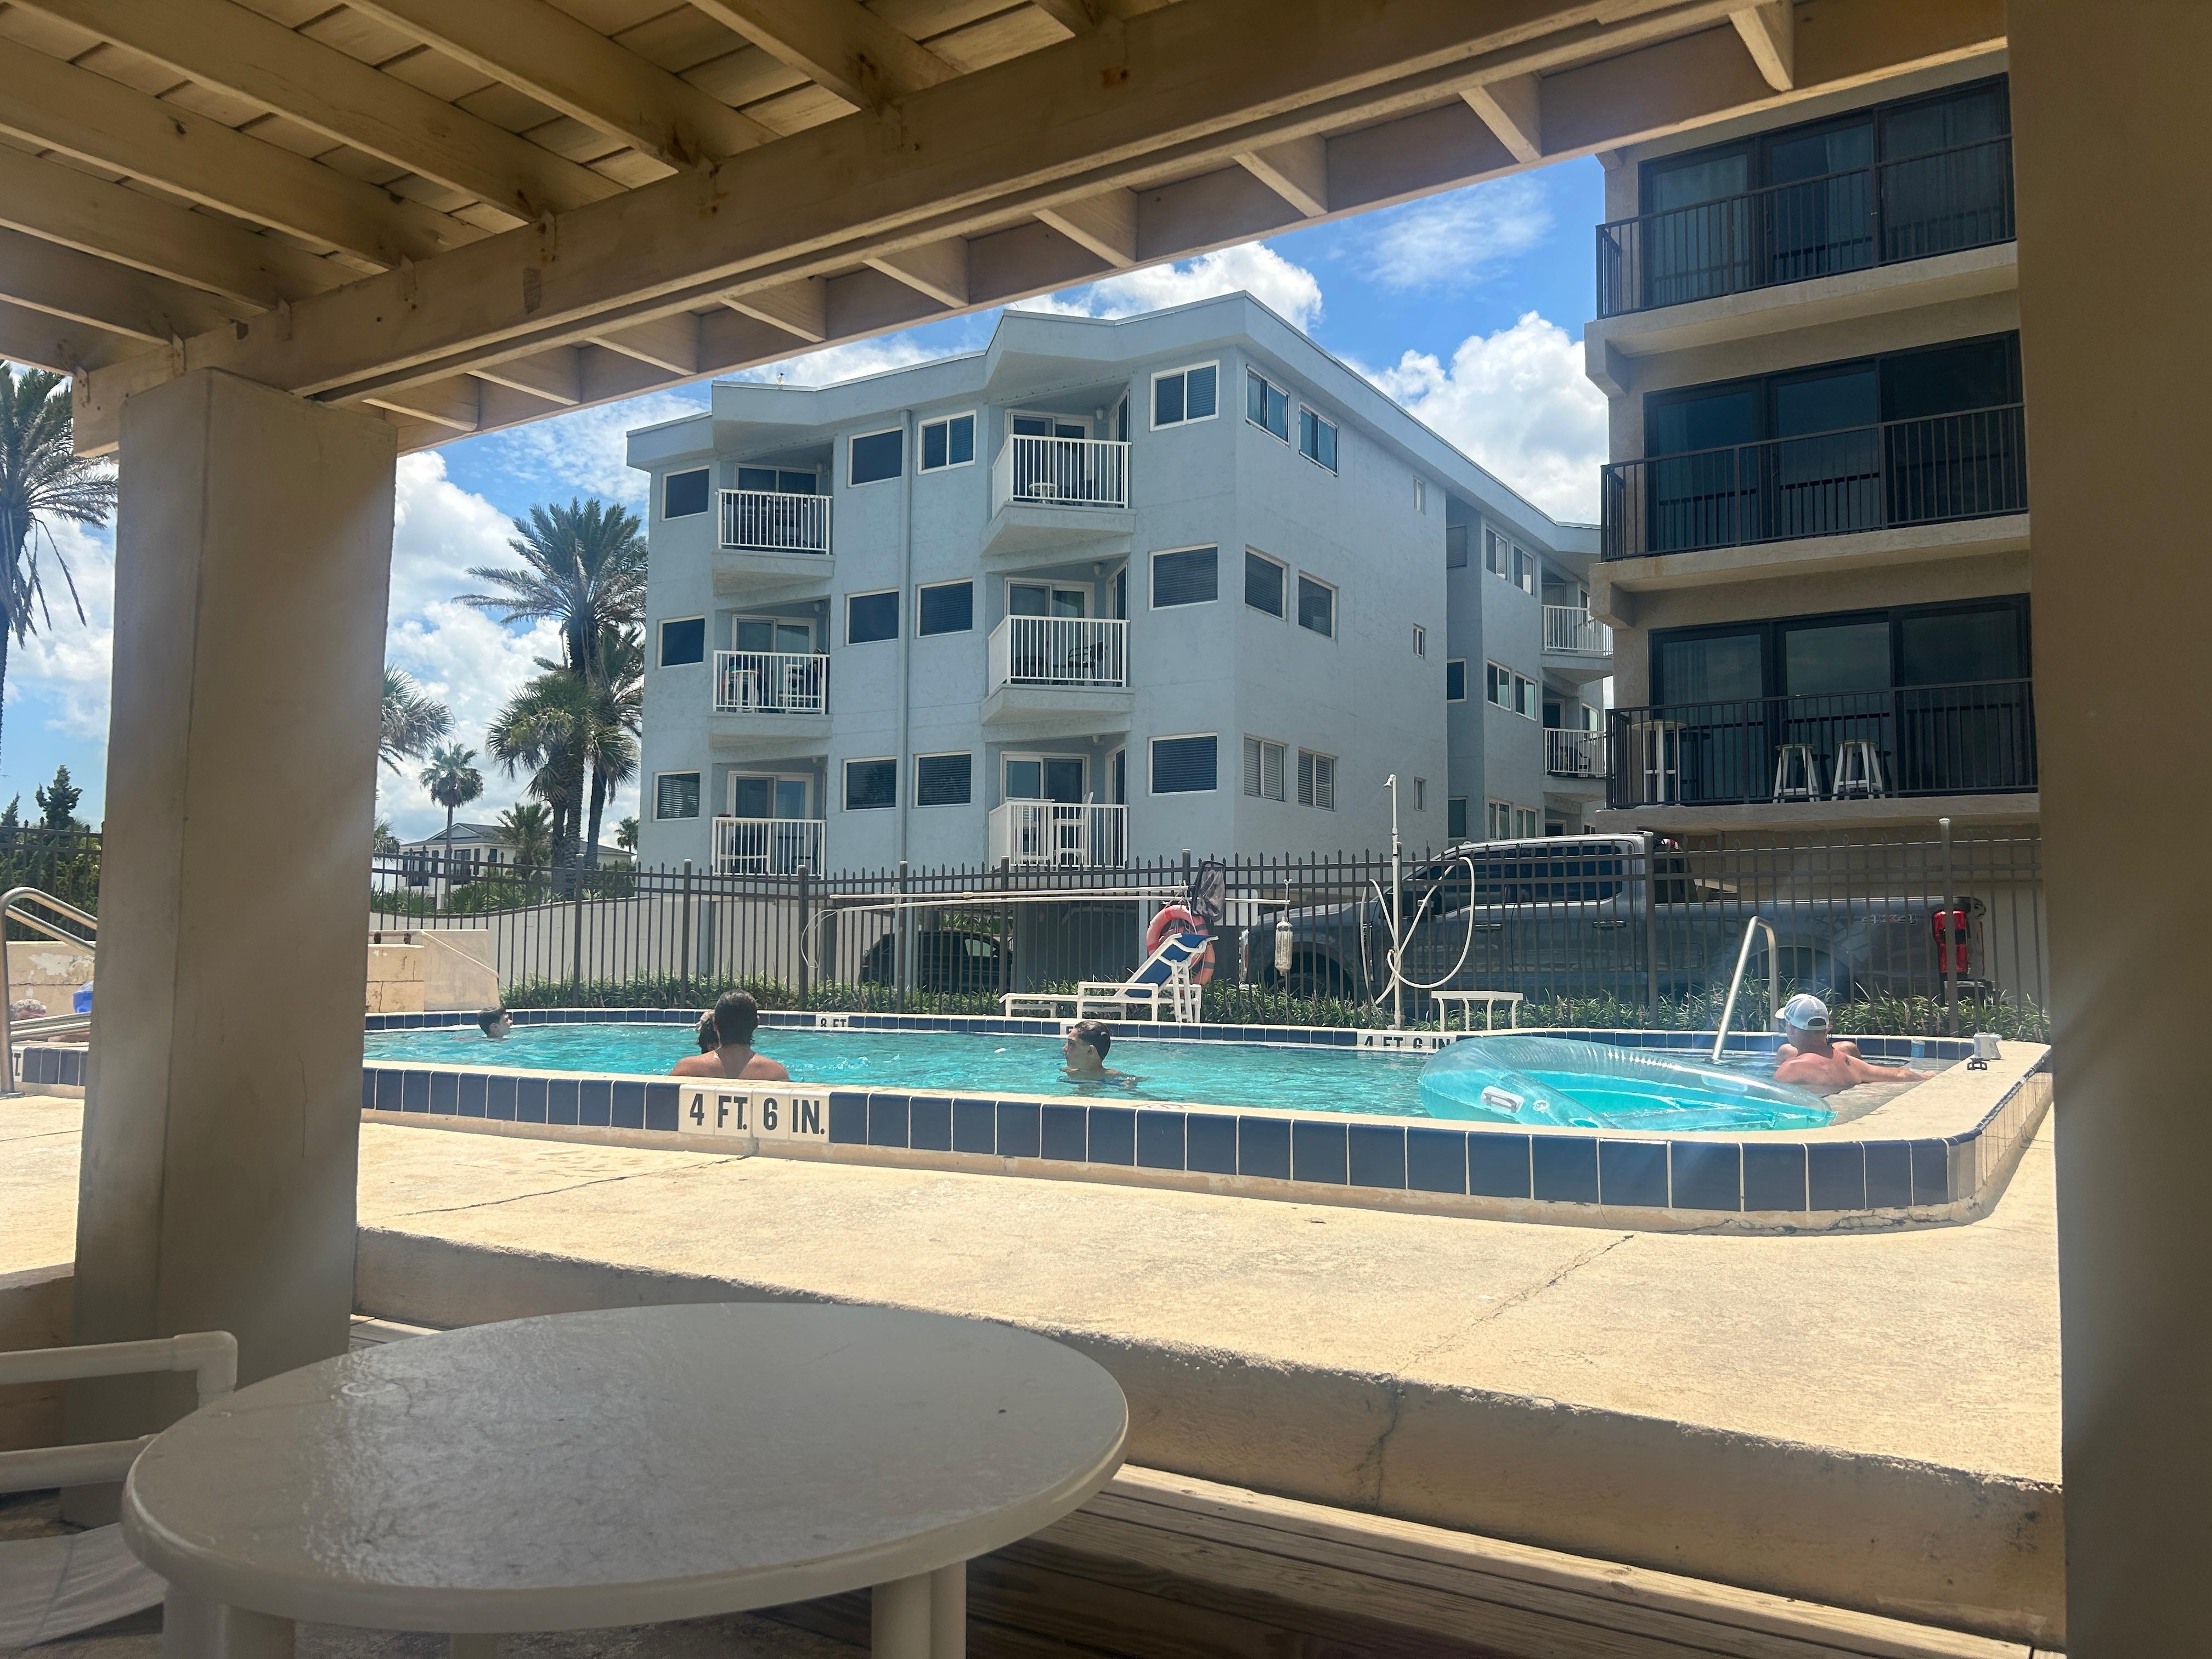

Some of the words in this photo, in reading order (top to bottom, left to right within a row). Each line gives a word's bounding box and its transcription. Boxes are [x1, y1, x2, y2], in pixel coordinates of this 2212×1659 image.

[820, 1018, 827, 1028] 8
[690, 1093, 705, 1126] 4
[718, 1095, 748, 1130] FT.
[763, 1097, 778, 1131] 6
[793, 1099, 825, 1135] IN.
